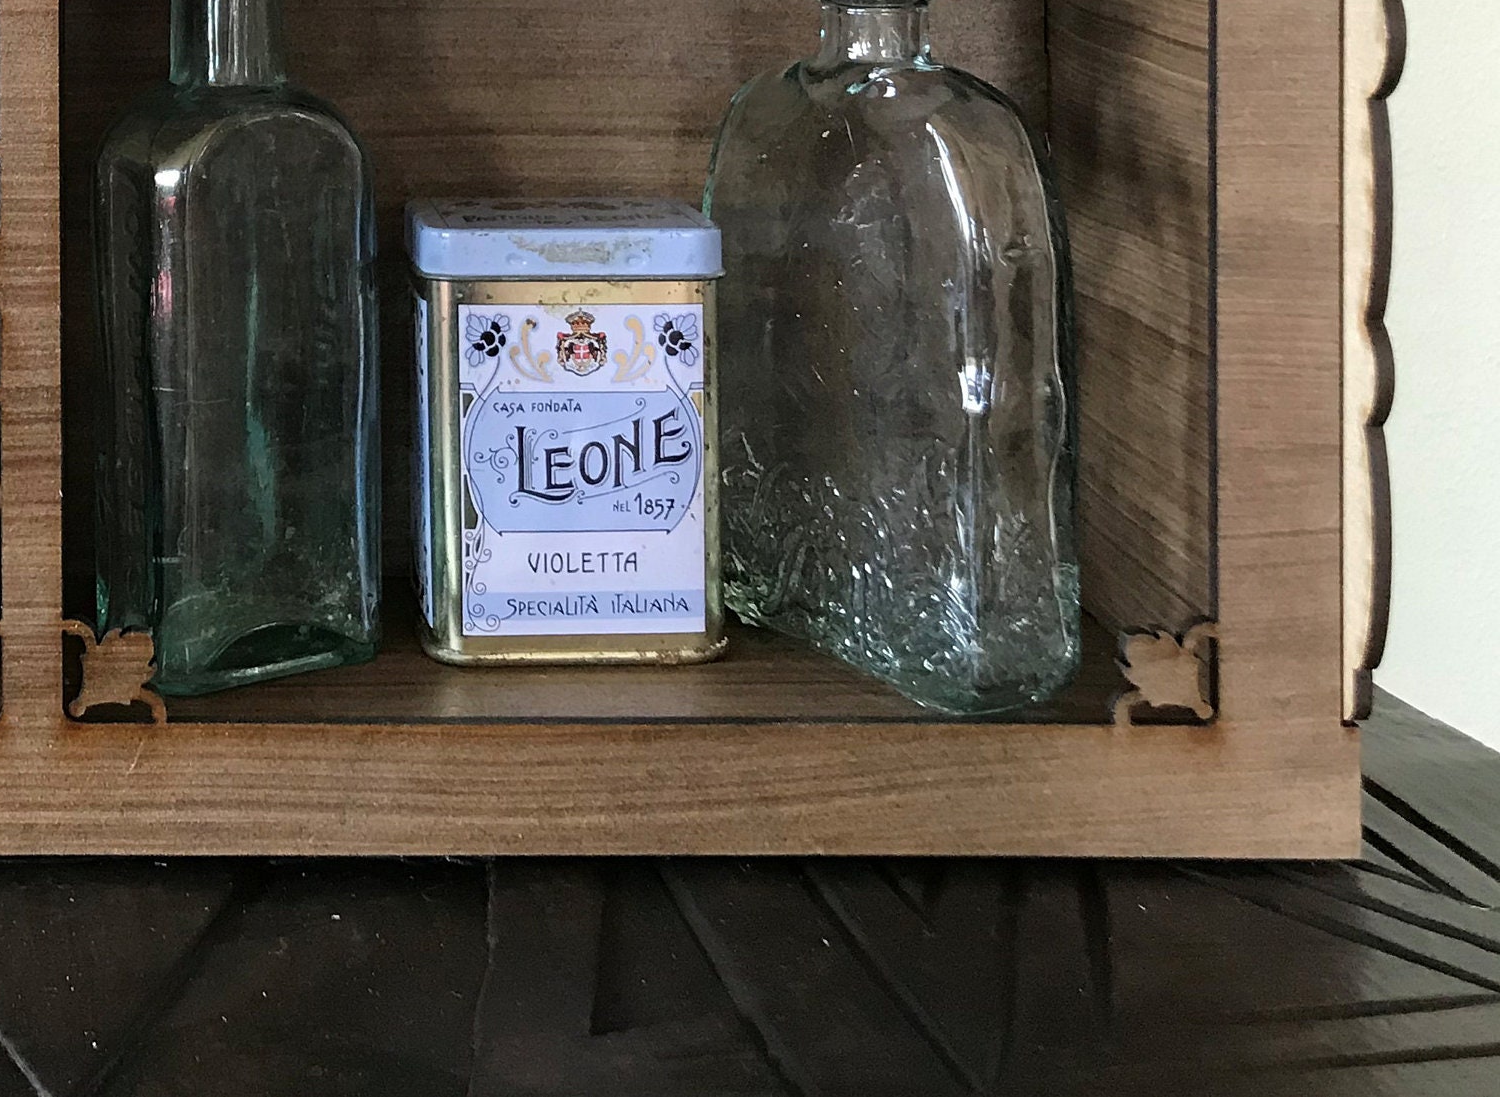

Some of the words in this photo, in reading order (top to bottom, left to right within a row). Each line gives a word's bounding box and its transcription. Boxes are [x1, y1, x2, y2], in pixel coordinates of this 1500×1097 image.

[493, 402, 525, 418] CASA
[531, 398, 583, 413] FONDATA
[509, 407, 693, 504] LEONE
[612, 502, 632, 513] NEL
[634, 492, 675, 520] 1857
[527, 551, 639, 574] VIOLETTA
[502, 594, 600, 621] SPECIALITÀ
[611, 592, 691, 614] ITALIANA
